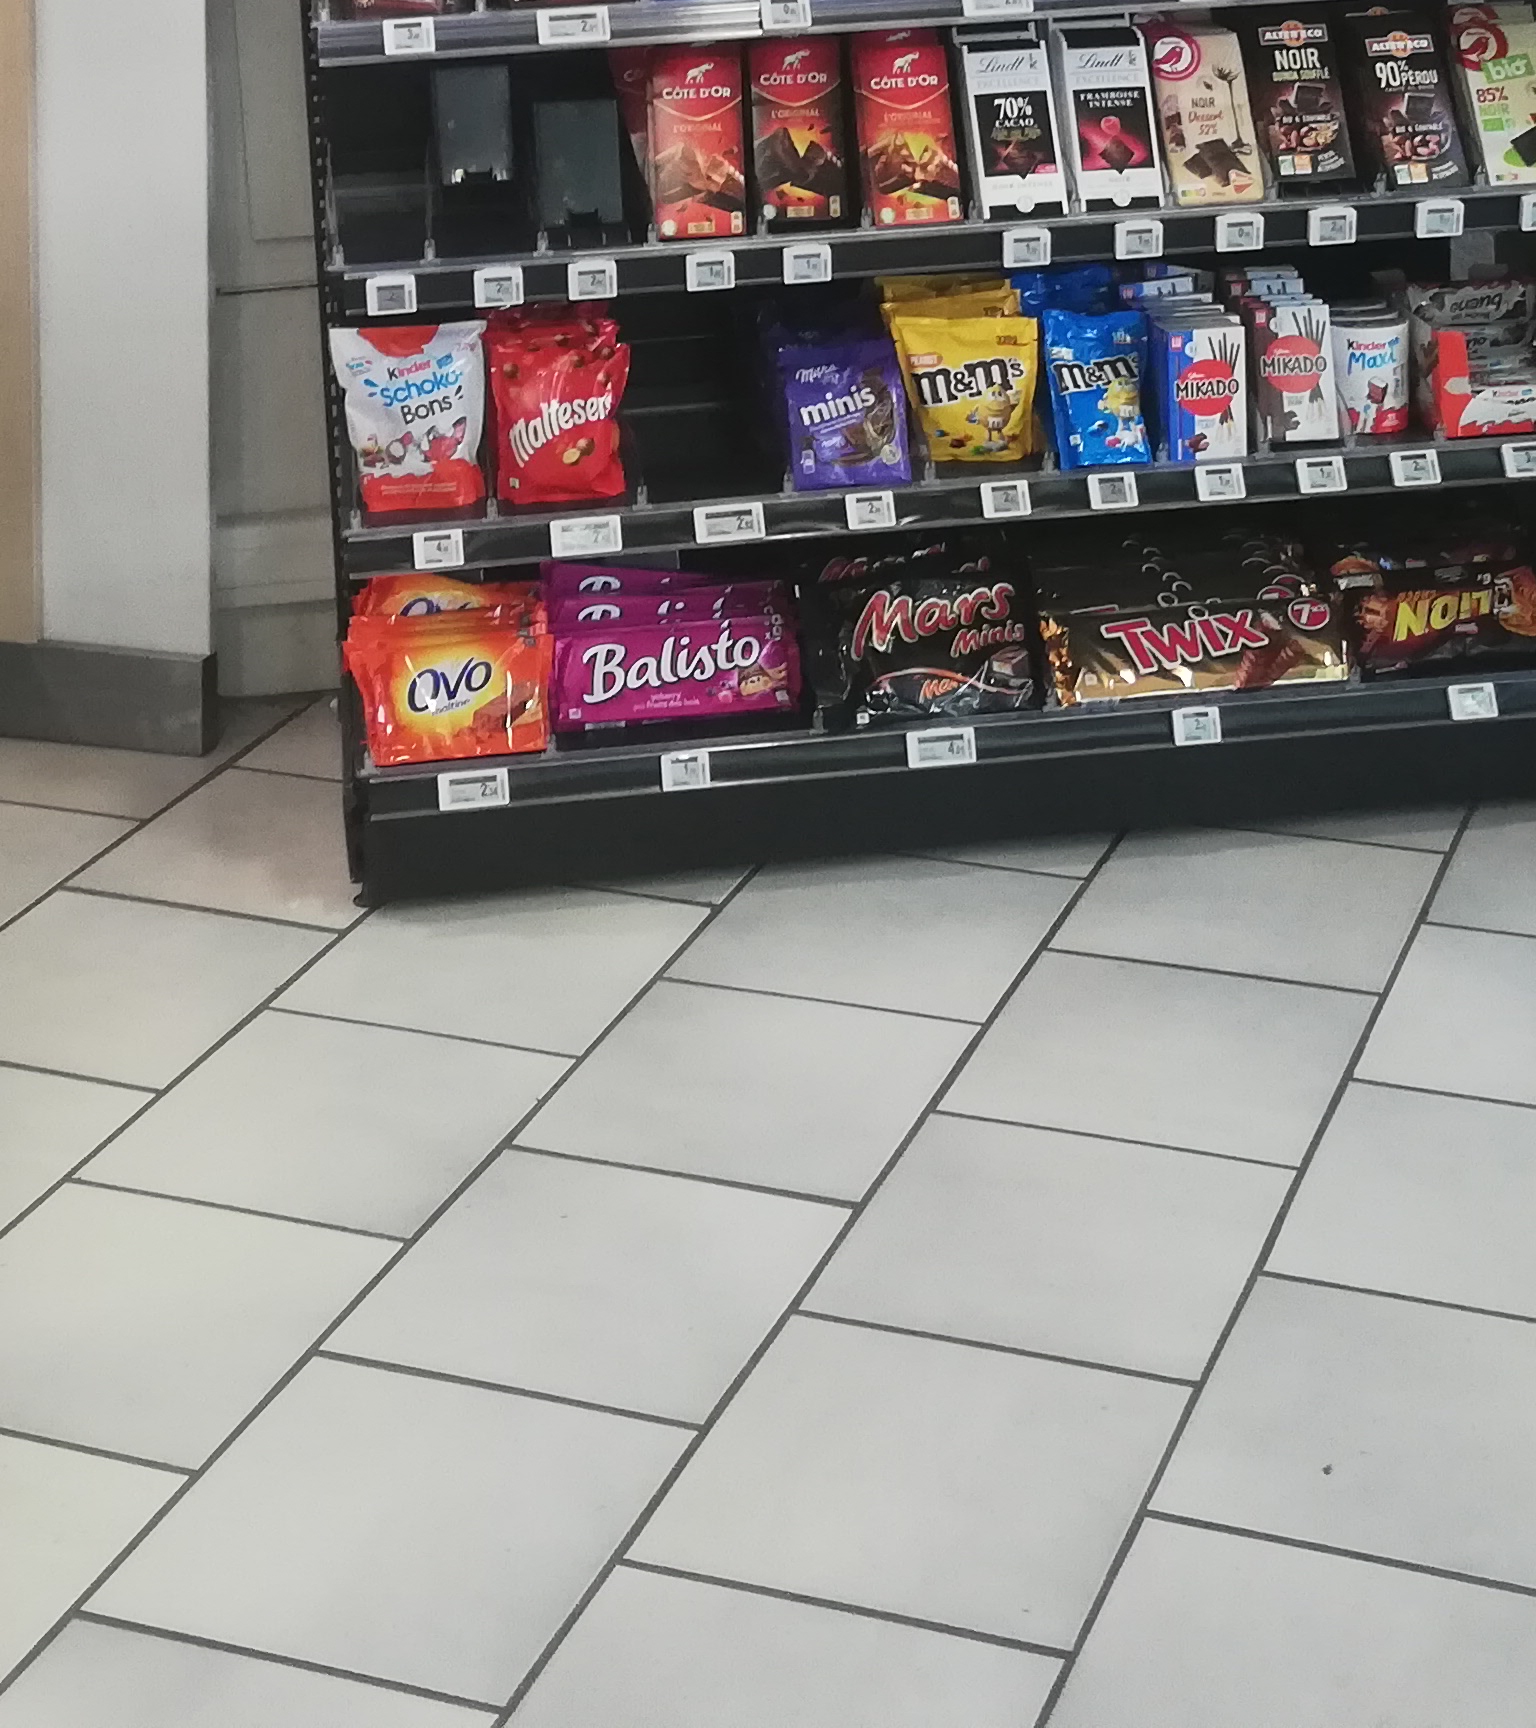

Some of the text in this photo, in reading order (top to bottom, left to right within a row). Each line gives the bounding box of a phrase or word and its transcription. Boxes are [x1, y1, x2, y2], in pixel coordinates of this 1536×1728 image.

[979, 56, 1025, 74] Lindt
[1078, 52, 1125, 70] Lindt
[1274, 48, 1321, 71] NOIR
[1487, 59, 1528, 81] bio
[1191, 97, 1216, 110] NOIR
[1475, 86, 1509, 103] 85%
[993, 96, 1033, 120] 70%
[995, 117, 1034, 129] CACAO
[1261, 355, 1328, 377] MIKADO
[1175, 377, 1240, 402] MIKADO
[401, 396, 453, 426] Bons
[800, 384, 876, 429] minis
[509, 393, 613, 469] Maltesers
[851, 582, 1015, 662] Mars
[951, 620, 1025, 659] minis
[582, 633, 763, 705] Balisto
